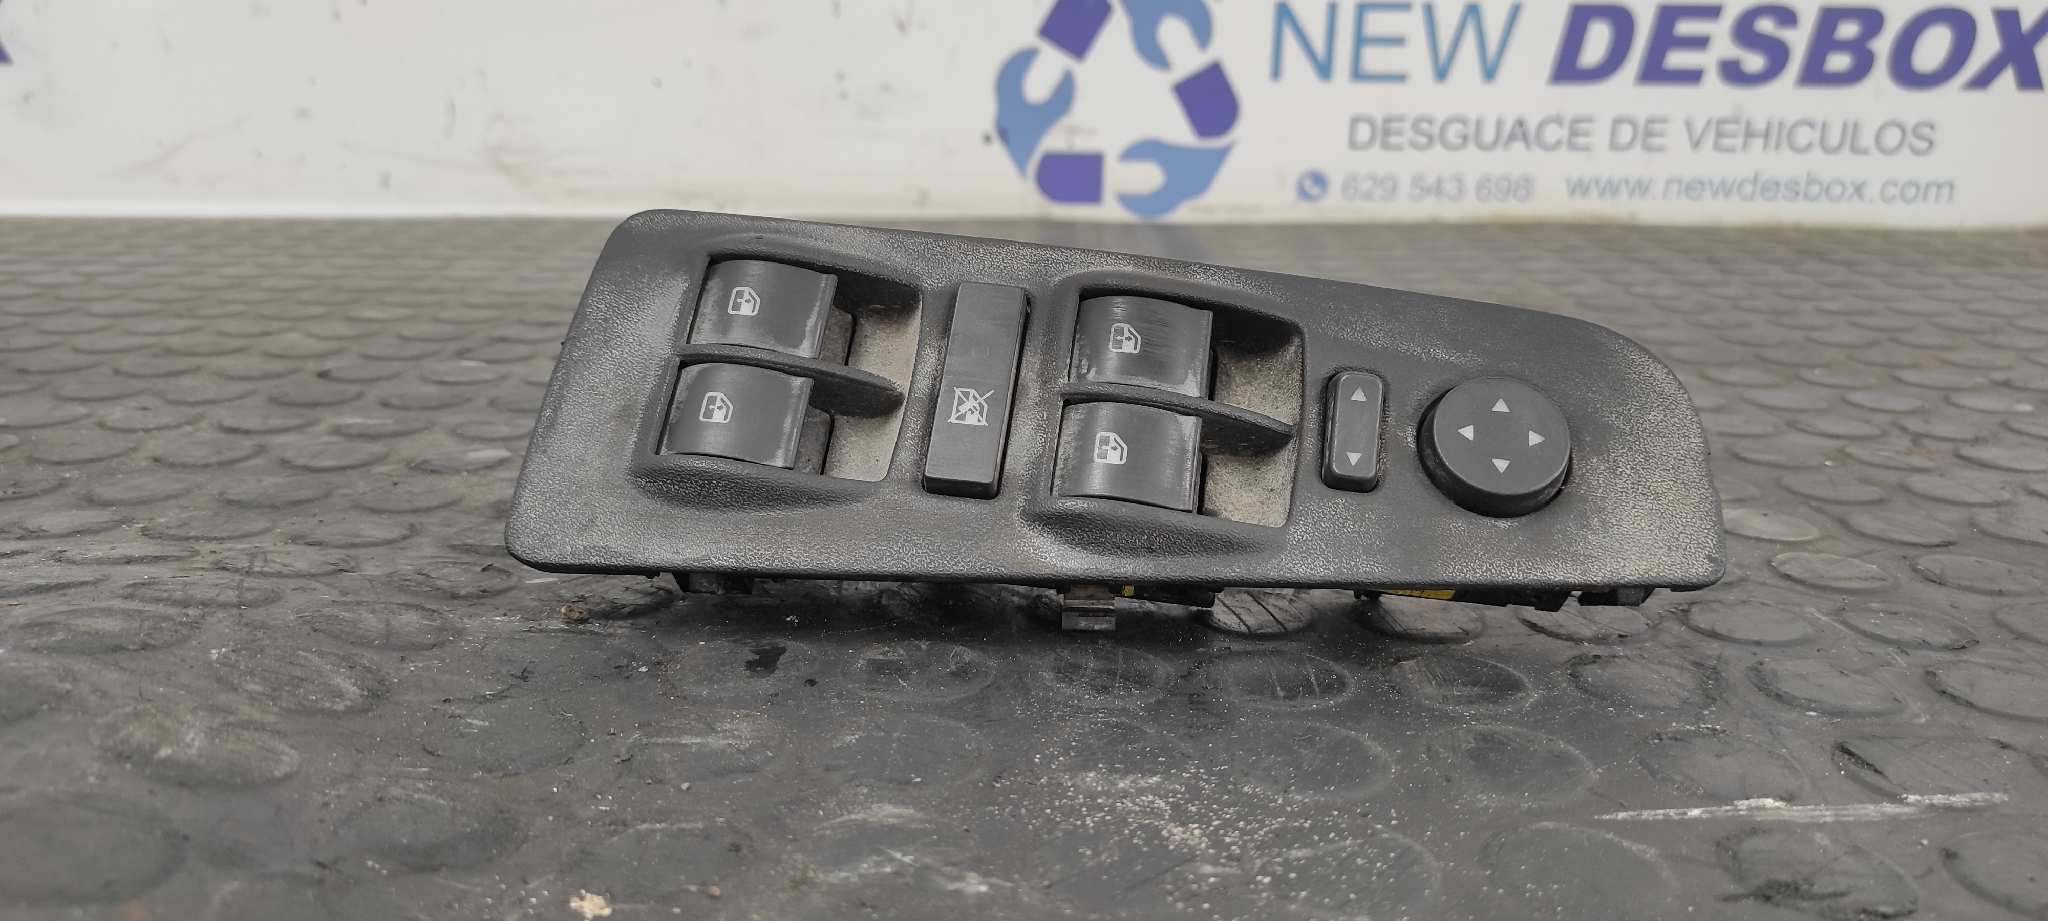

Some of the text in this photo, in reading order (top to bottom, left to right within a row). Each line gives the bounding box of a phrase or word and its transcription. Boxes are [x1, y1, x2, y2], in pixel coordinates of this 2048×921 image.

[1270, 0, 2048, 92] NEW DESBOX
[1347, 114, 1594, 152] DESGUACE
[1608, 117, 1668, 152] DE
[1341, 172, 1956, 204] 629 543 698 www.newdesbox.com
